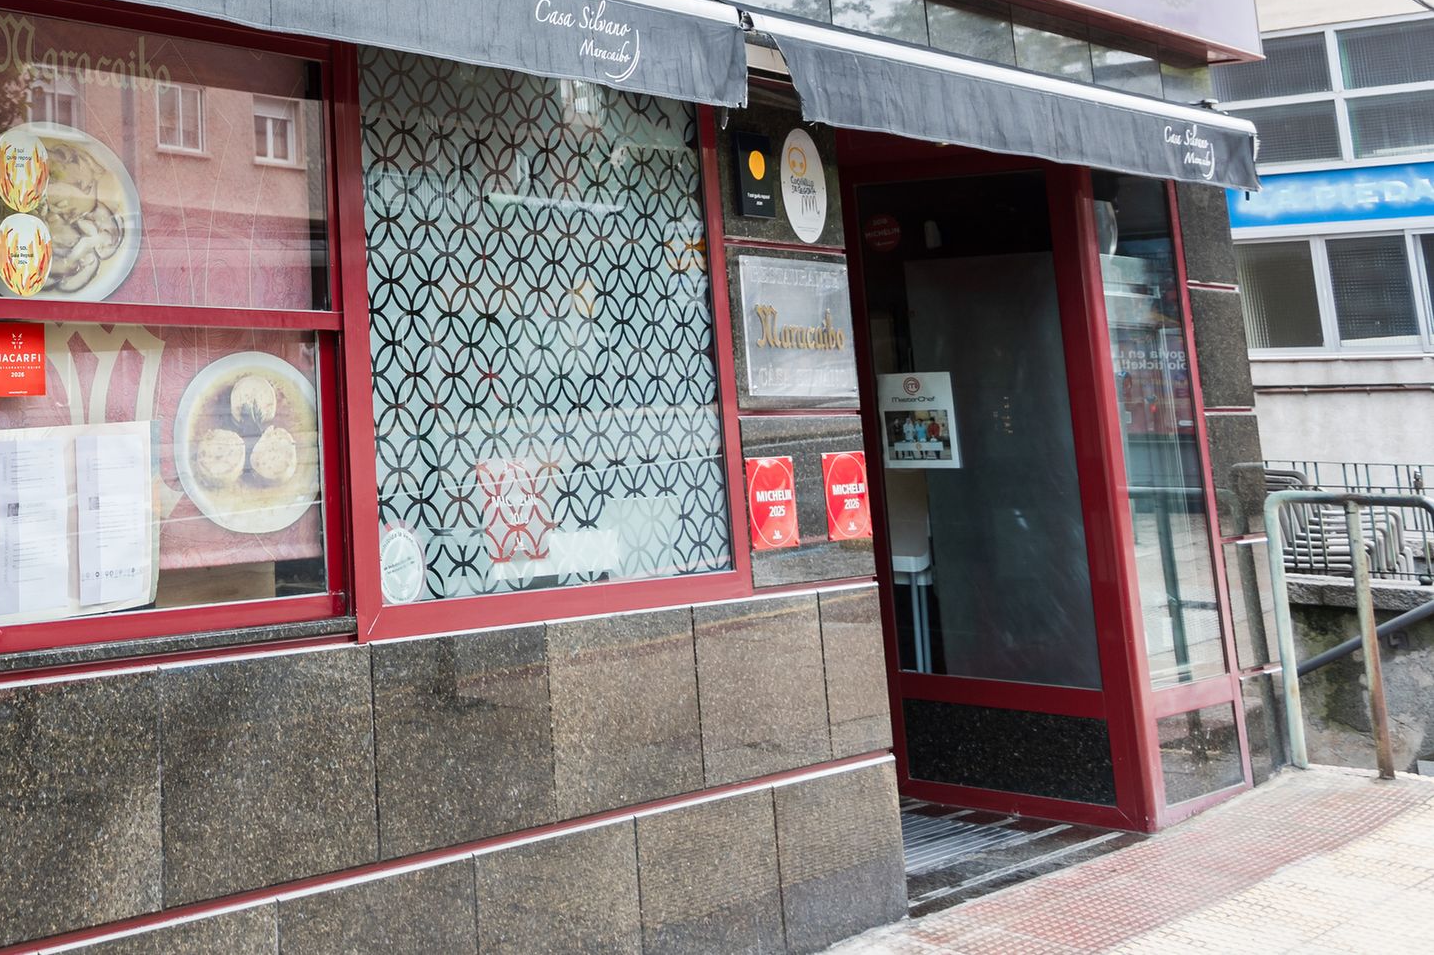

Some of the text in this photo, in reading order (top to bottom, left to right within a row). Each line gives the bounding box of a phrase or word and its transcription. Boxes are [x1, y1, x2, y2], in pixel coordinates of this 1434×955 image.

[579, 0, 631, 36] Silvano
[579, 39, 631, 62] Maracaibo
[754, 303, 845, 352] Maracaibo
[756, 489, 793, 502] MICHELIN
[832, 482, 866, 496] MICHELIN
[768, 505, 786, 517] 2025
[843, 498, 860, 510] 2026
